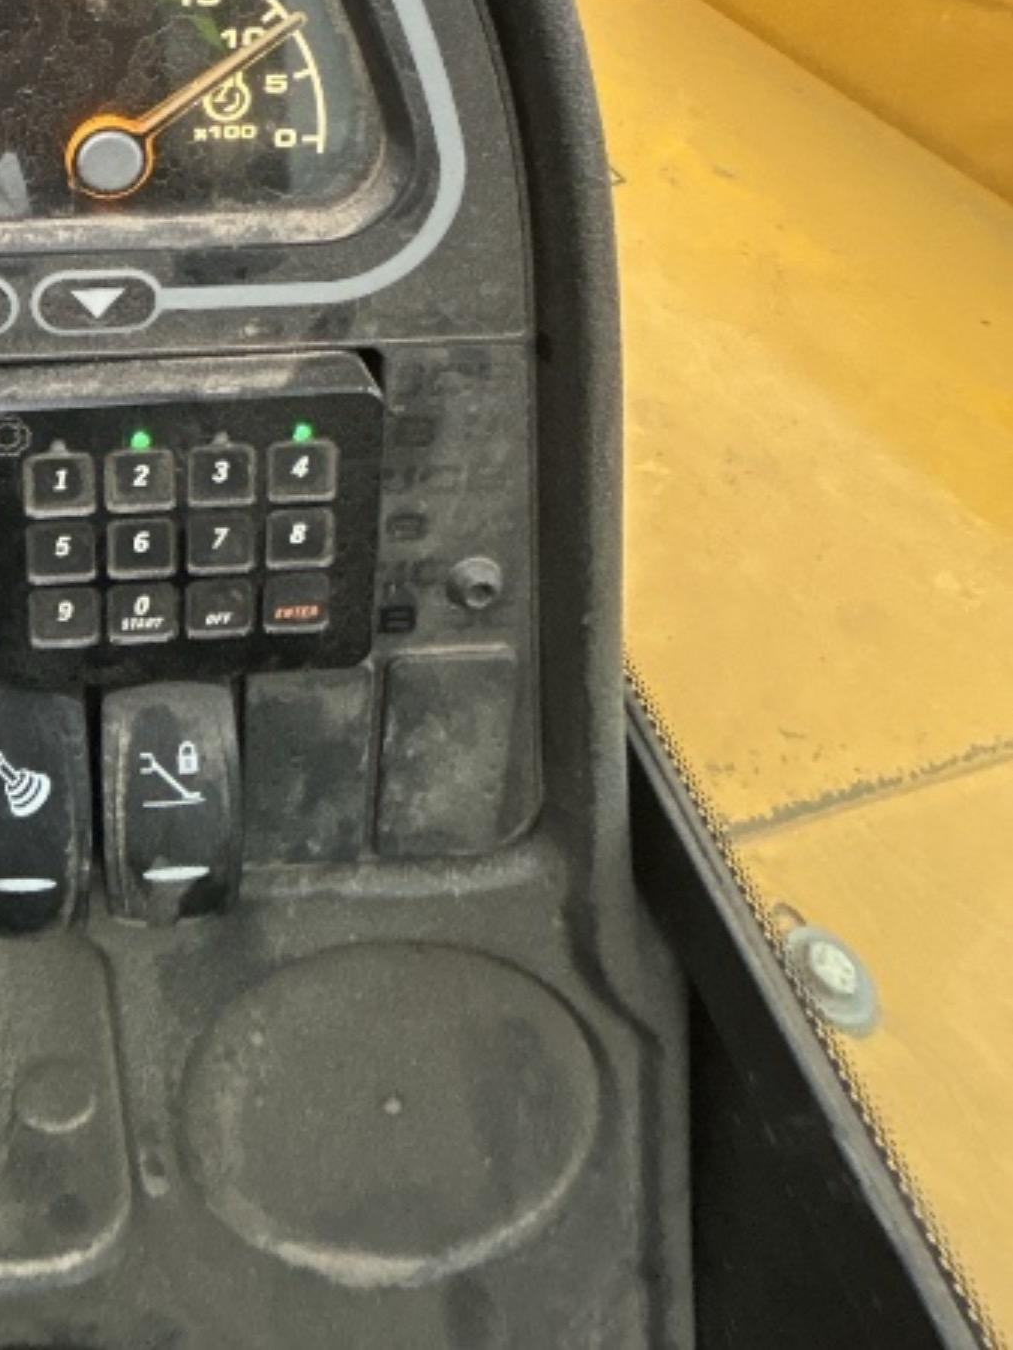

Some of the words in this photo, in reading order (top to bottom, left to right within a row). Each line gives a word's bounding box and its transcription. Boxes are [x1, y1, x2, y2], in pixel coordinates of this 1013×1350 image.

[264, 73, 289, 94] 5
[274, 128, 297, 148] 0
[132, 463, 151, 487] 2
[211, 460, 230, 484] 3
[291, 455, 310, 479] 4
[52, 468, 69, 491] 1
[133, 530, 151, 553] 6
[212, 527, 230, 550] 7
[289, 522, 308, 545] 8
[54, 535, 71, 558] 5
[57, 600, 75, 623] 9
[133, 594, 151, 616] 0
[205, 611, 234, 626] OFF
